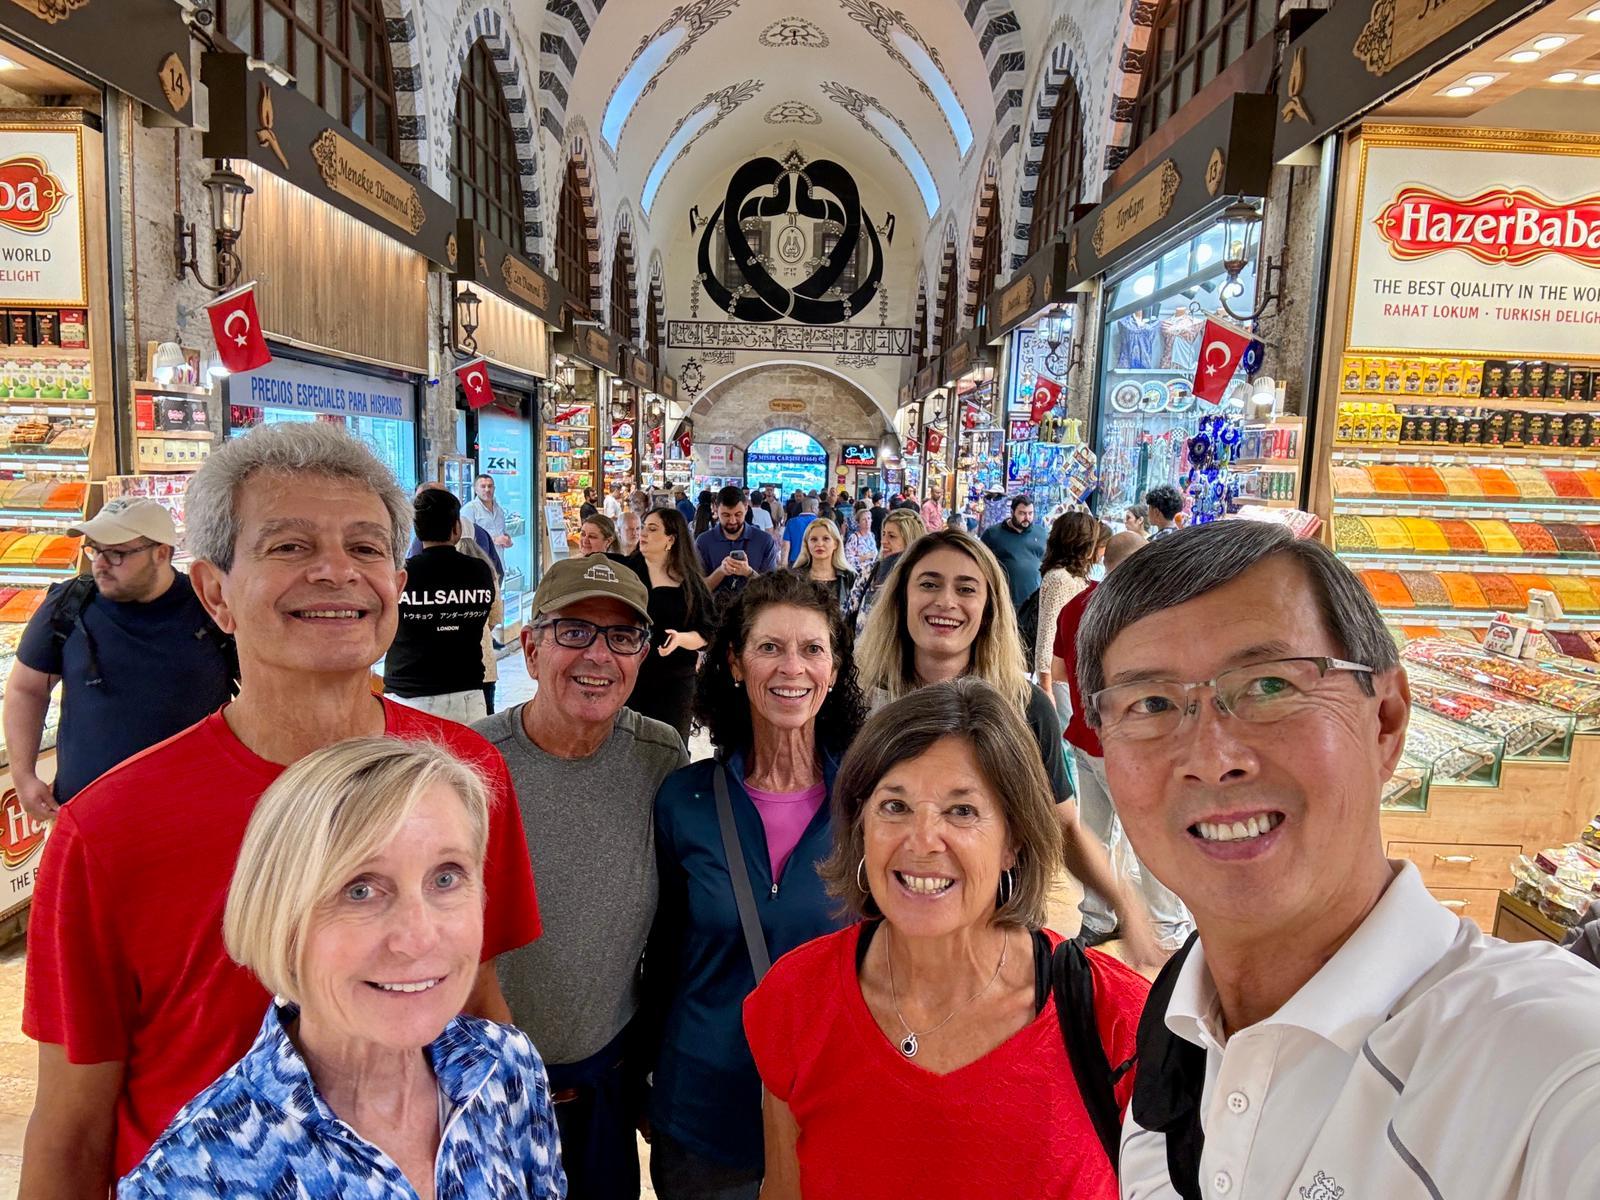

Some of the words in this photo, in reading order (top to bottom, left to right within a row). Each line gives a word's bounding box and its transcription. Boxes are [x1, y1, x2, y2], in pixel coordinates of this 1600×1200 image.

[169, 68, 184, 96] 14
[375, 180, 410, 217] Diamond
[1400, 202, 1600, 250] HazerBaba
[2, 247, 52, 262] WORLD
[1373, 279, 1403, 295] THE
[1407, 280, 1446, 297] BEST
[1450, 281, 1514, 299] QUALITY
[1518, 284, 1534, 300] IN
[1539, 285, 1568, 301] THE
[1573, 286, 1600, 302] WO
[1383, 303, 1429, 317] RAHAT
[1433, 304, 1480, 319] LOKUM
[1495, 307, 1551, 322] TURKISH
[251, 376, 293, 404] PRECIOS
[296, 383, 346, 411] ESPECIALES
[348, 391, 368, 412] PARA
[370, 393, 403, 416] HISPANOS
[487, 457, 517, 469] ZEN
[398, 589, 492, 606] ALLSAINTS
[403, 611, 434, 620] トウキョウ
[440, 610, 488, 619] アンダーグラウンド
[10, 871, 31, 892] THE
